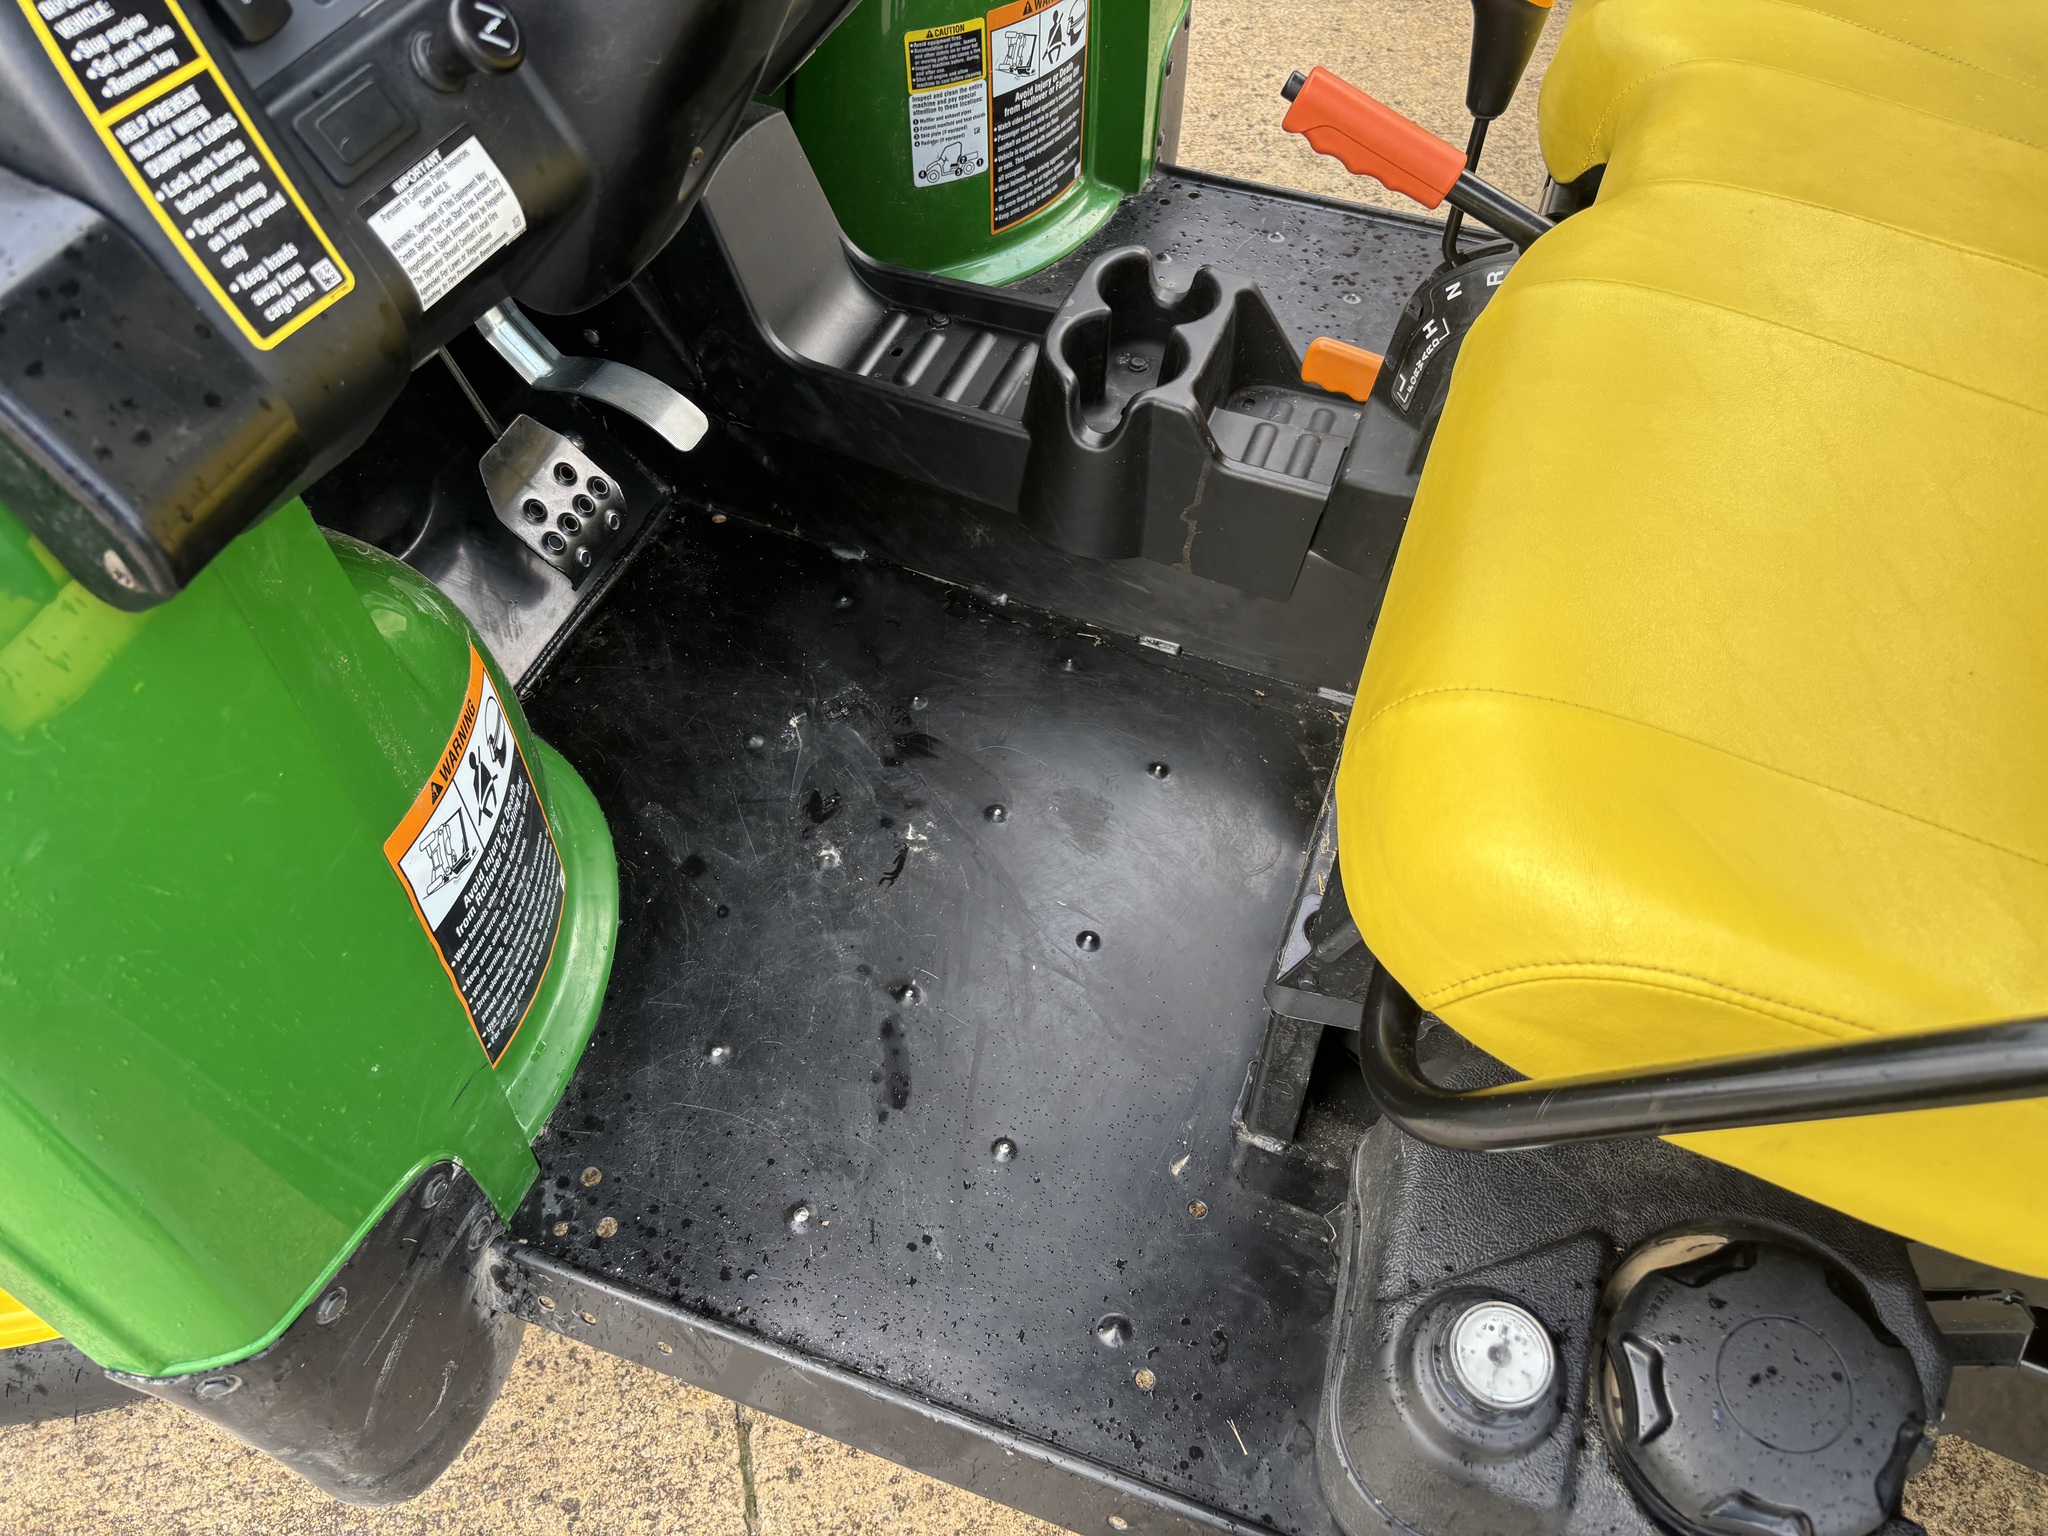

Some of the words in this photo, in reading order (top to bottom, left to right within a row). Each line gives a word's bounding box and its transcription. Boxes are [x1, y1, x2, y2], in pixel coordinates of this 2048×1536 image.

[934, 24, 965, 37] CAUTION
[911, 94, 932, 102] Inspect
[944, 89, 958, 97] clean
[968, 83, 983, 91] entire
[912, 101, 936, 109] machine
[958, 91, 976, 101] special
[1004, 104, 1020, 117] from
[1022, 90, 1048, 109] Rollover
[1048, 85, 1055, 95] or
[1055, 73, 1072, 91] Falling
[1015, 86, 1033, 102] Avoid
[1034, 77, 1052, 93] Injury
[1052, 73, 1059, 83] or
[1059, 61, 1073, 78] Death
[116, 115, 149, 144] HELP
[146, 86, 199, 125] PREVENT
[130, 126, 175, 160] INJURY
[171, 105, 211, 135] WHEN
[913, 107, 937, 116] attention
[144, 136, 201, 178] DUMPING
[196, 113, 237, 146] LOADS
[161, 172, 193, 198] Lock
[189, 156, 217, 184] park
[211, 139, 245, 166] brake
[392, 149, 441, 193] IMPORTANT
[174, 184, 214, 214] before
[211, 156, 259, 192] dumping
[193, 201, 238, 235] Operate
[235, 182, 267, 208] dump
[380, 200, 405, 222] Pursuant
[401, 197, 410, 205] to
[407, 179, 432, 200] California
[429, 167, 447, 183] Public
[444, 149, 470, 171] Resources
[414, 211, 439, 233] Operation
[437, 204, 445, 215] of
[441, 198, 455, 210] This
[451, 178, 478, 202] Equipment
[474, 171, 488, 182] May
[418, 195, 434, 209] Code
[208, 234, 226, 252] on
[220, 214, 252, 242] level
[248, 192, 286, 227] ground
[398, 248, 417, 264] Create
[414, 234, 433, 251] Sparks
[430, 223, 445, 236] That
[441, 217, 453, 228] Can
[450, 206, 465, 221] Start
[461, 198, 476, 211] Fires
[473, 183, 492, 201] Around
[488, 177, 501, 189] Dry
[413, 274, 424, 285] The
[422, 257, 444, 278] Operator
[442, 242, 460, 261] Should
[458, 228, 477, 248] Contact
[475, 217, 490, 234] Local
[487, 211, 498, 223] Fire
[432, 244, 439, 254] A
[436, 234, 453, 250] Spark
[468, 210, 481, 223] May
[478, 205, 487, 215] be
[221, 245, 248, 268] only
[236, 264, 268, 289] Keep
[262, 243, 298, 271] hands
[251, 279, 282, 305] away
[276, 263, 305, 287] from
[419, 275, 441, 296] Agencies
[439, 268, 448, 279] For
[448, 258, 461, 272] Laws
[460, 253, 466, 262] or
[465, 232, 492, 257] Regulations
[1487, 270, 1504, 287] R
[264, 294, 296, 321] cargo
[290, 281, 315, 301] box
[1445, 281, 1463, 302] N
[1422, 319, 1439, 340] H
[1398, 374, 1407, 393] L
[1407, 338, 1440, 393] FORWARD
[439, 699, 476, 782] WARNING
[456, 906, 476, 937] from
[475, 853, 502, 906] Rollover
[501, 837, 508, 853] or
[506, 797, 521, 838] Falling
[463, 869, 484, 908] Avoid
[483, 833, 501, 871] Injury
[499, 818, 506, 834] or
[504, 784, 516, 819] Death
[454, 939, 469, 962] Wear
[468, 908, 488, 940] helmets
[487, 887, 499, 909] when
[497, 860, 511, 888] driving
[460, 963, 467, 974] or
[467, 935, 485, 965] uneven
[484, 909, 501, 936] terrain,
[499, 896, 505, 907] or
[504, 886, 510, 898] at
[507, 863, 519, 889] higher
[465, 965, 480, 987] Keep
[479, 944, 492, 966] arms
[491, 928, 501, 946] and
[499, 912, 509, 930] legs
[507, 903, 513, 913] in
[512, 879, 523, 904] during
[471, 974, 487, 998] While
[503, 924, 514, 945] drive
[513, 905, 522, 925] slow
[476, 989, 490, 1010] Drive
[489, 966, 504, 991] slowly
[502, 947, 514, 969] when
[481, 996, 497, 1023] paved
[486, 1016, 497, 1032] Use
[496, 991, 512, 1017] brakes
[511, 969, 524, 993] going
[522, 949, 532, 970] down
[490, 1029, 500, 1044] For
[500, 998, 518, 1030] off-road
[517, 985, 525, 1000] use
